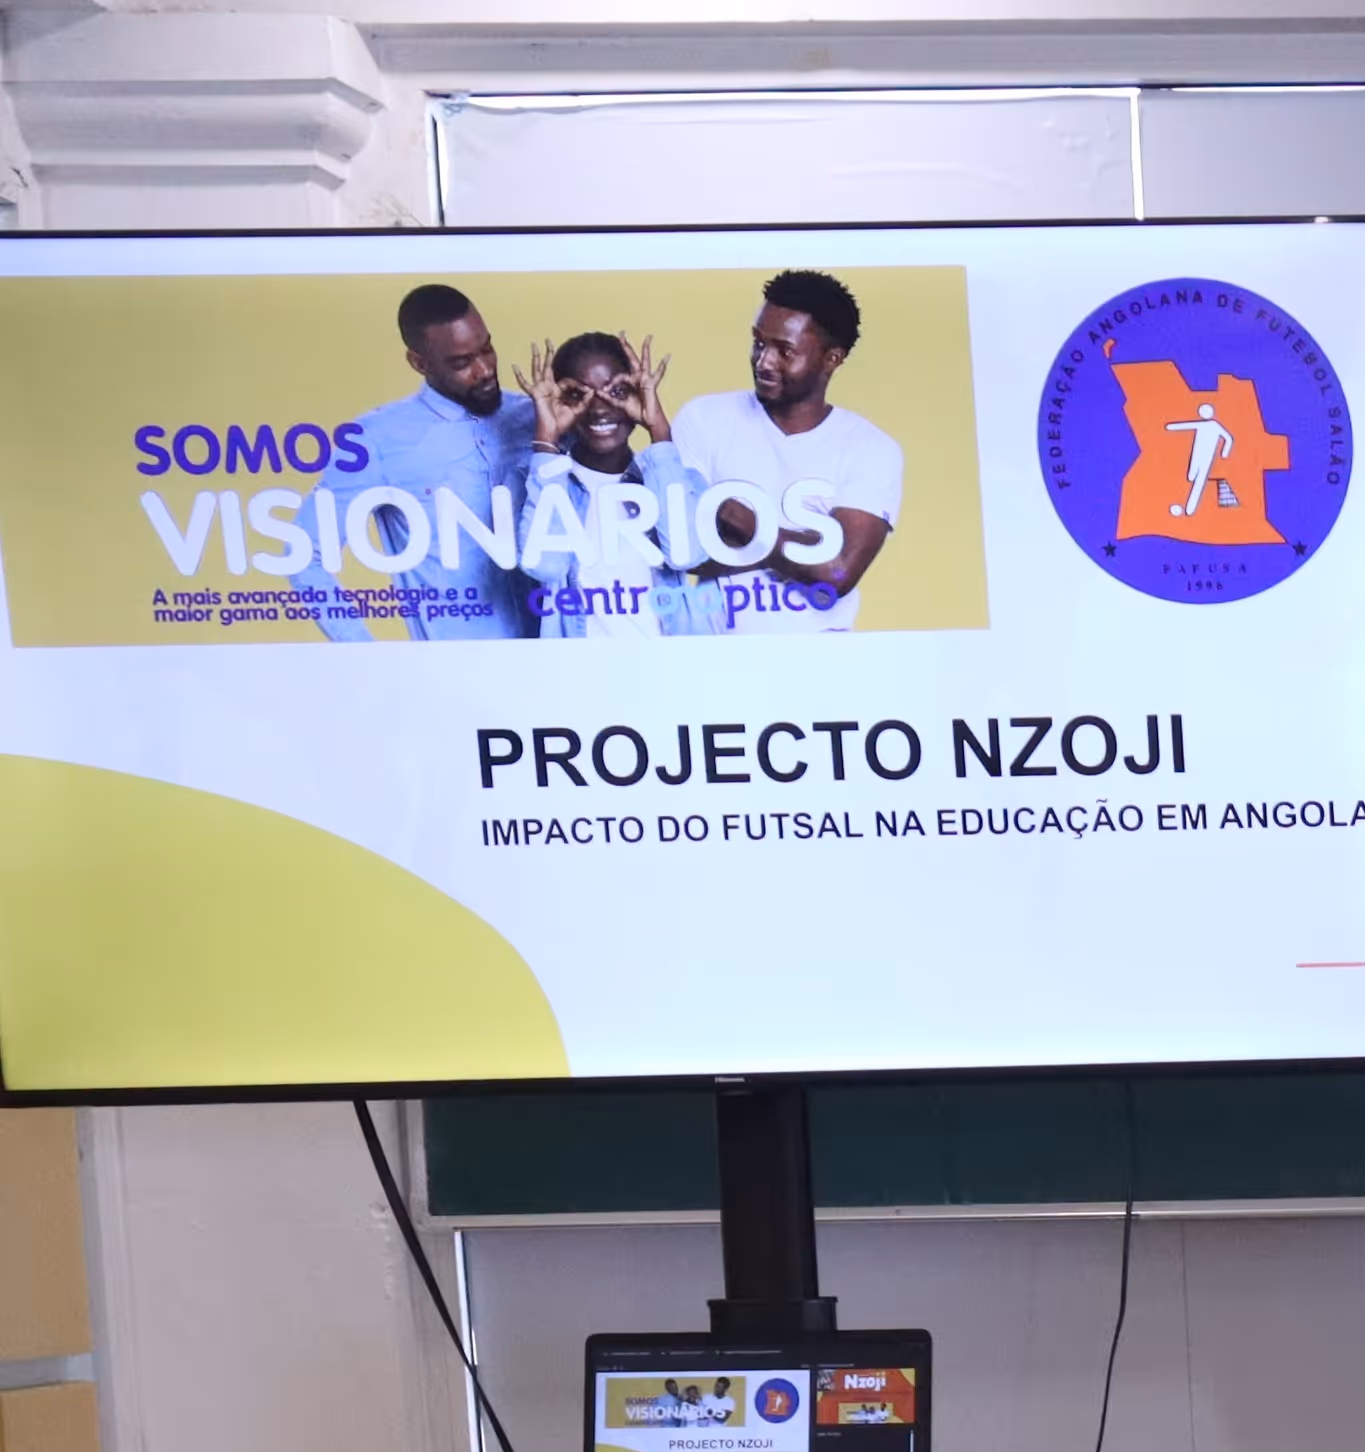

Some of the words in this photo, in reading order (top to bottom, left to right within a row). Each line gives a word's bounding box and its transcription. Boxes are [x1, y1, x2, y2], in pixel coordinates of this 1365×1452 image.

[1088, 288, 1204, 346] ANGOLANA
[1217, 293, 1244, 315] DE
[1255, 308, 1331, 397] FUTEBOL
[135, 422, 370, 476] SOMOS
[140, 455, 846, 578] VISIONÁRIOS
[152, 590, 168, 606] A
[173, 587, 222, 606] mais
[228, 586, 328, 608] avançada
[334, 584, 439, 605] tecnologia
[445, 587, 459, 601] e
[464, 587, 479, 601] a
[154, 604, 214, 623] maior
[220, 606, 279, 626] gama
[286, 604, 322, 621] aos
[328, 602, 421, 619] melhores
[427, 600, 493, 622] preços
[476, 720, 923, 789] PROJECTO
[951, 712, 1188, 779] NZOJI
[481, 816, 645, 846] IMPACTO
[658, 815, 709, 842] DO
[722, 811, 863, 841] FUTSAL
[876, 810, 926, 838] NA
[937, 798, 1144, 839] EDUCAÇÃO
[1157, 803, 1208, 831] EM
[668, 1439, 734, 1450] PROJECTO
